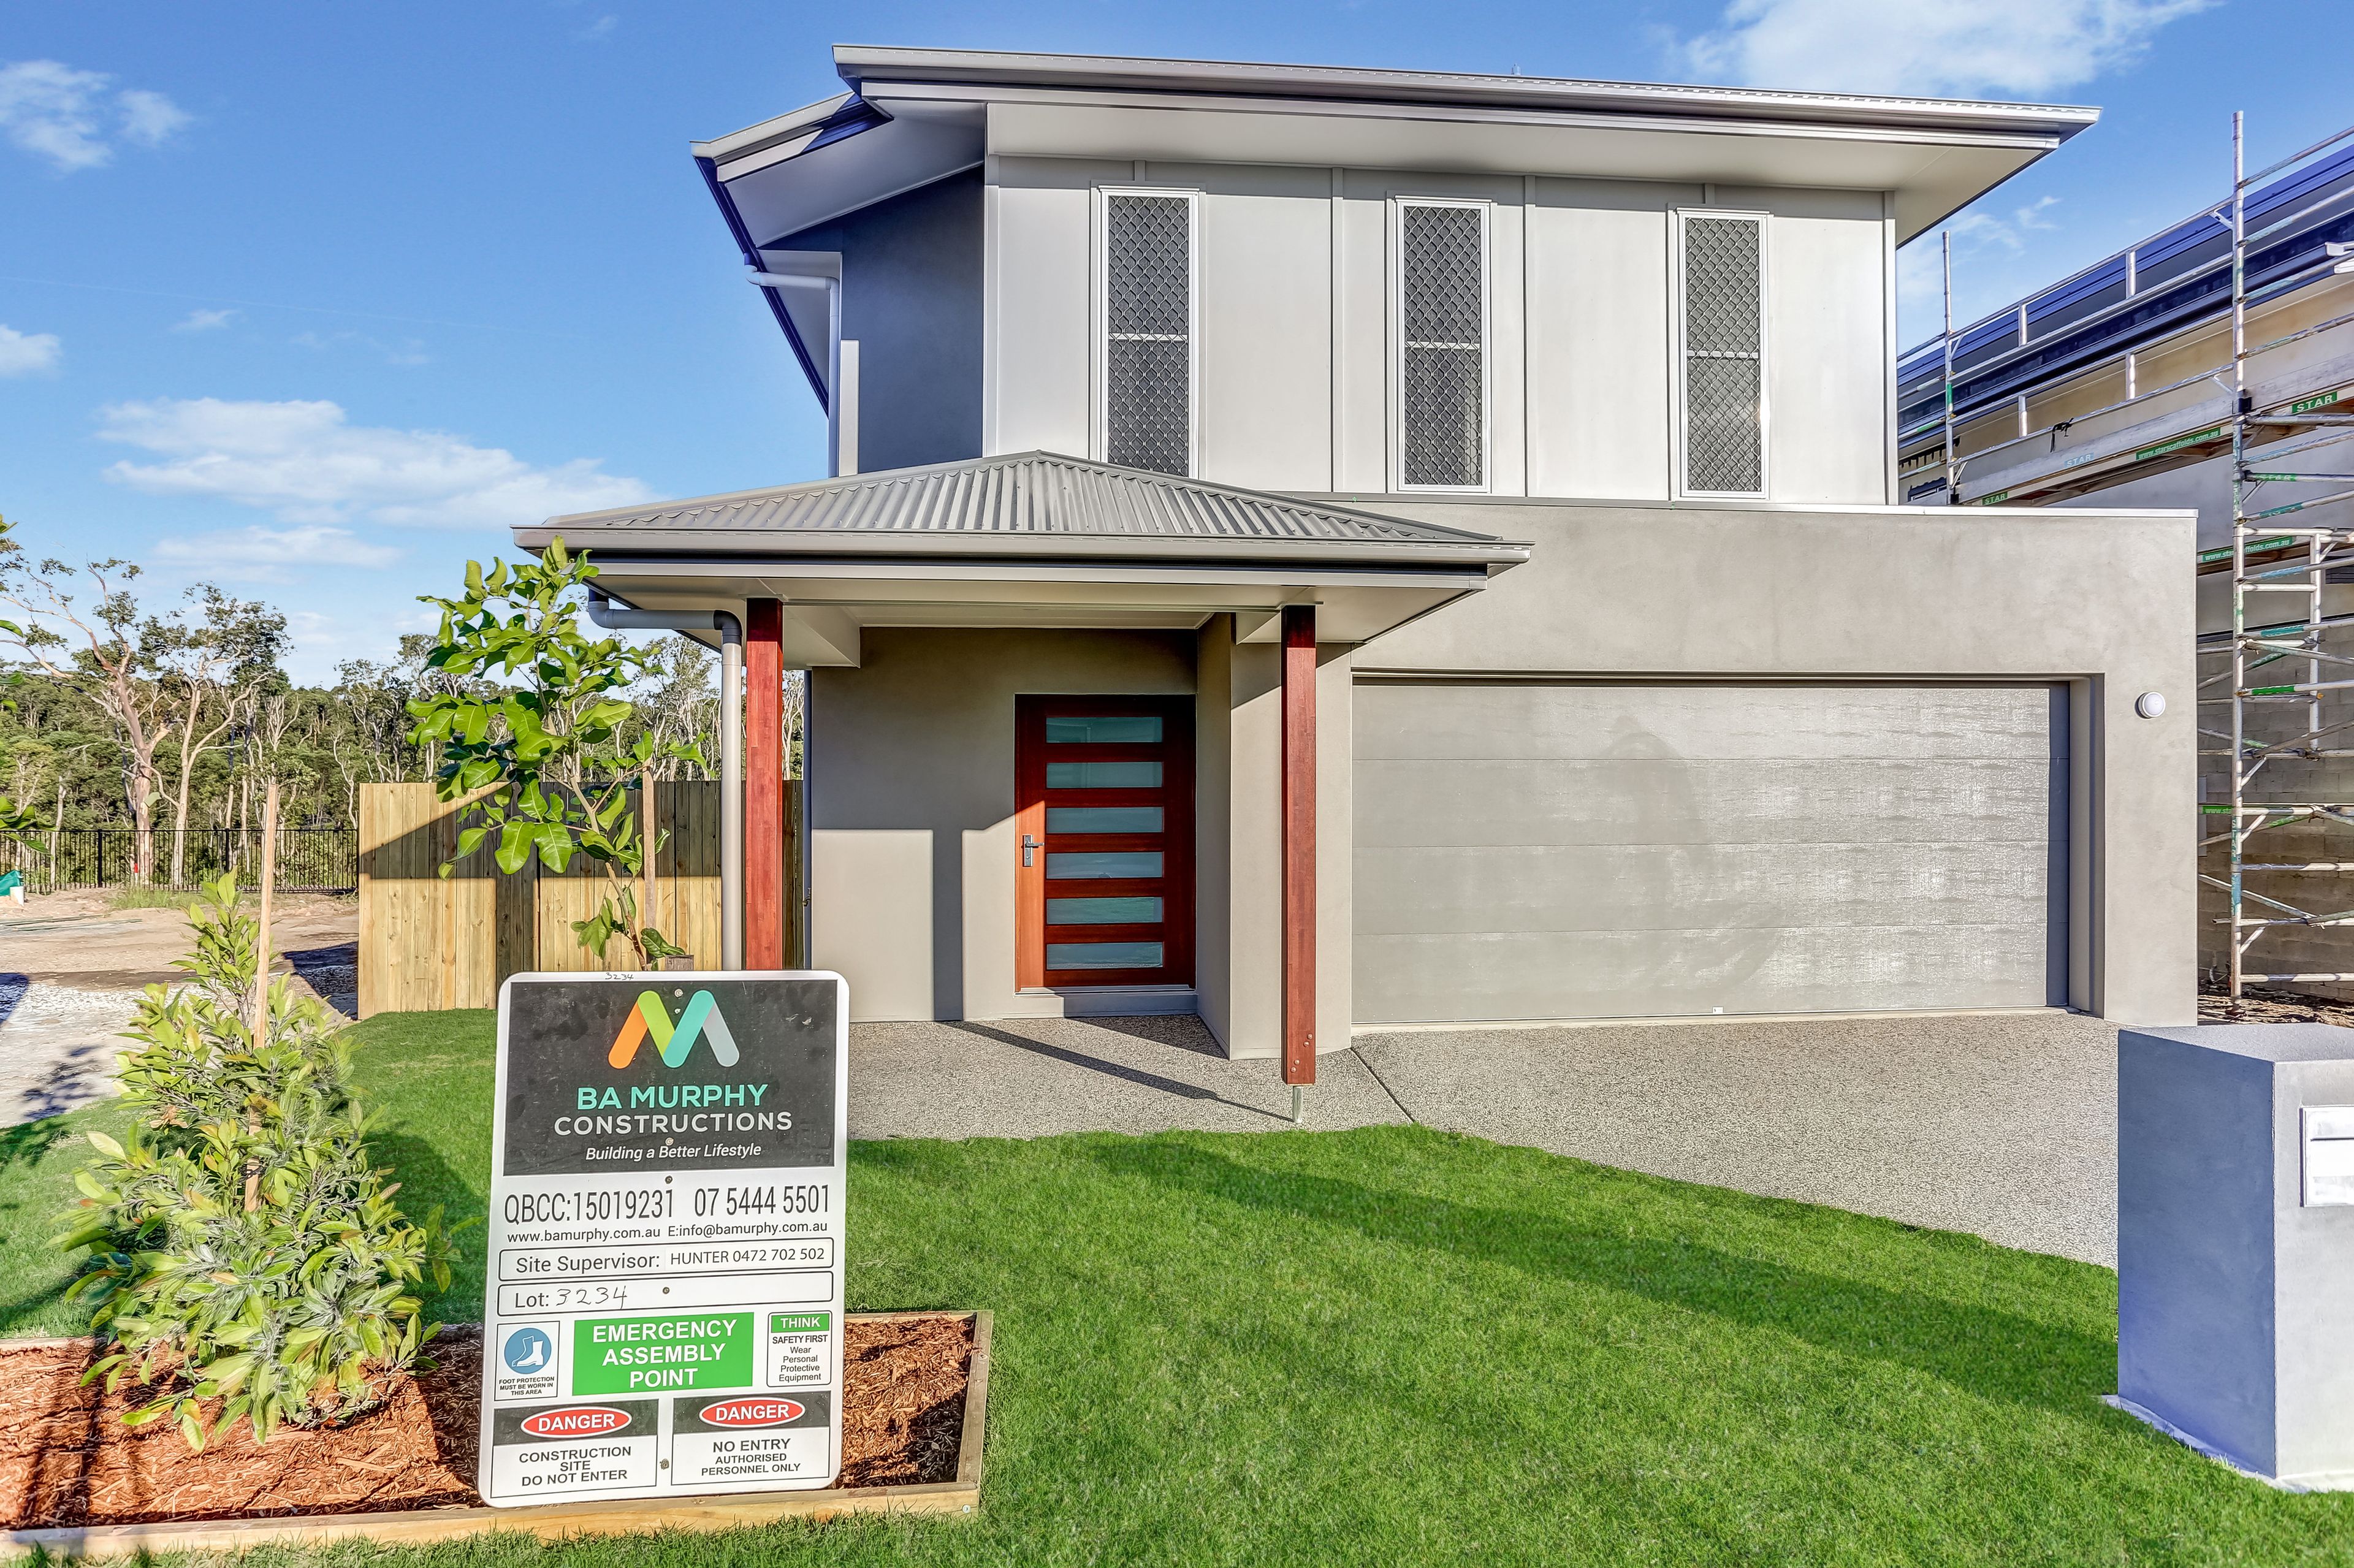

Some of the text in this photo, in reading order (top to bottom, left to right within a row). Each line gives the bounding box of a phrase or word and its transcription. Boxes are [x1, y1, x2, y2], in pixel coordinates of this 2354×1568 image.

[2297, 395, 2333, 412] STAR
[2138, 430, 2219, 459] www.starscaffolds.com.au
[2067, 454, 2091, 467] STAR
[1984, 493, 2005, 504] STAR
[604, 972, 634, 981] 3234
[577, 1084, 768, 1109] BA MURPHY
[554, 1111, 793, 1136] CONSTRUCTIONS
[585, 1143, 761, 1162] Building a Better Lifestyle
[504, 1184, 829, 1225] QBCC:15019231 07 5444 5501
[507, 1221, 828, 1243] www.bamurphy.com.au E:info@bamurphy.com.au
[516, 1248, 825, 1274] Site Supervisor: HUNTER 0472 702 502
[515, 1292, 549, 1309] Lot:
[556, 1286, 628, 1310] 3234
[593, 1319, 737, 1343] EMERGENCY
[780, 1317, 820, 1329] THINK
[772, 1335, 804, 1344] SAFETY
[602, 1343, 726, 1366] ASSEMBLY
[790, 1345, 812, 1354] Wear
[783, 1355, 818, 1363] Personal
[780, 1364, 820, 1372] Protective
[630, 1368, 698, 1388] POINT
[779, 1372, 821, 1383] Equipment
[715, 1404, 790, 1421] DANGER
[538, 1414, 615, 1431] DANGER
[713, 1438, 791, 1453] NO ENTRY
[519, 1446, 631, 1463] CONSTRUCTION
[715, 1453, 787, 1464] AUTHORISED
[560, 1460, 590, 1472] SITE
[701, 1463, 801, 1476] PERSONNEL ONLY
[522, 1470, 628, 1486] DO NOT ENTER
